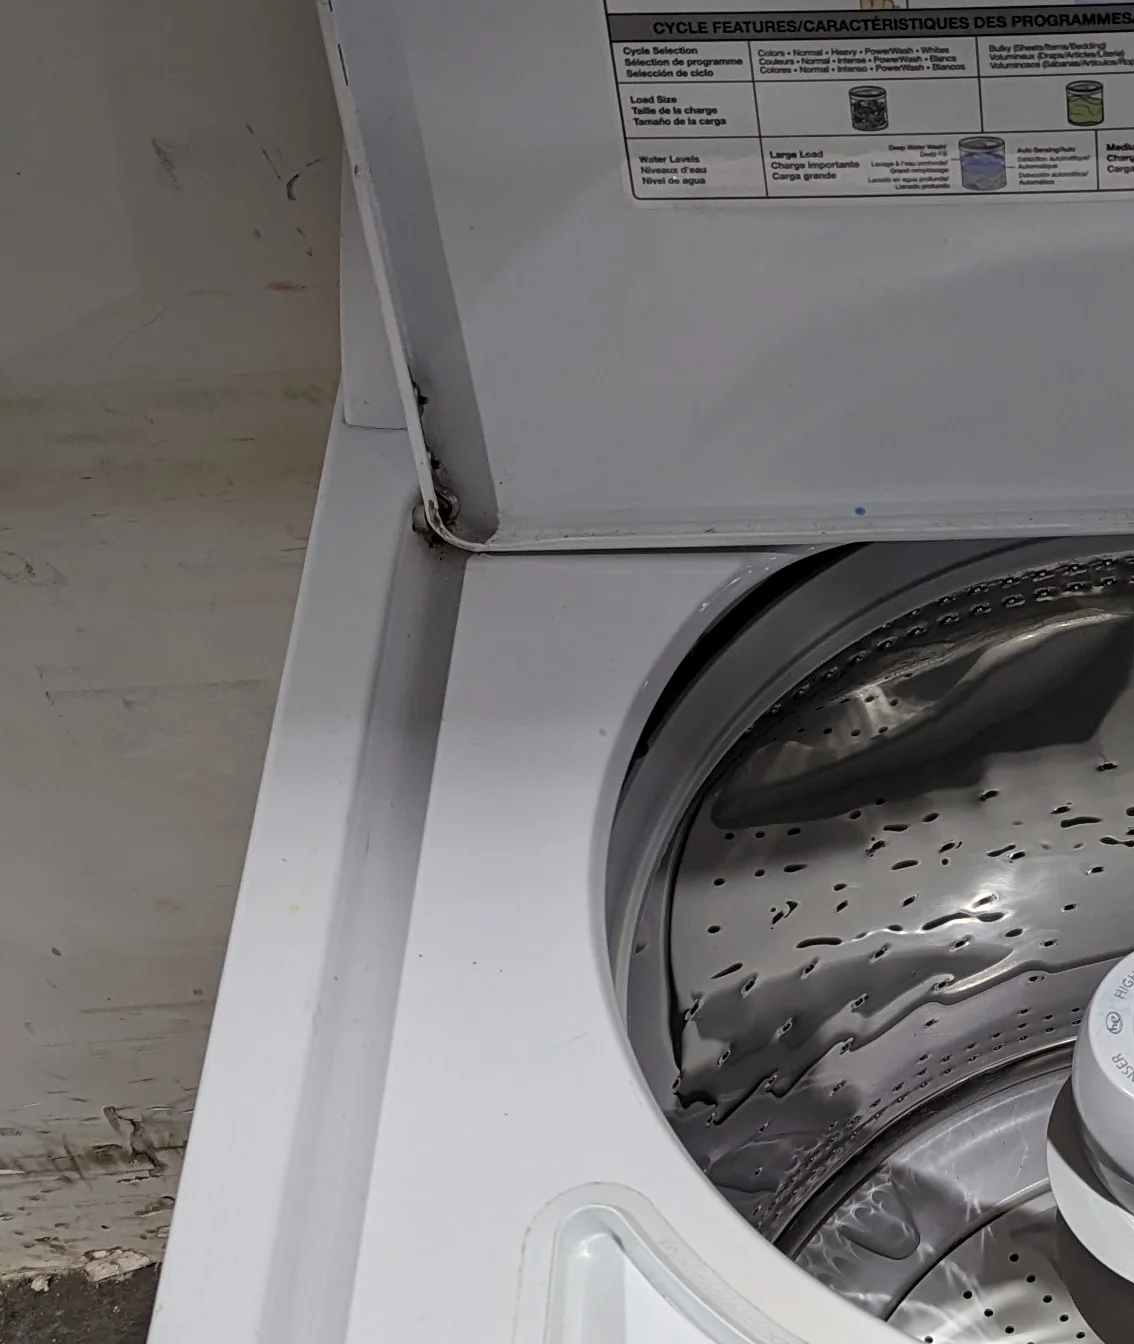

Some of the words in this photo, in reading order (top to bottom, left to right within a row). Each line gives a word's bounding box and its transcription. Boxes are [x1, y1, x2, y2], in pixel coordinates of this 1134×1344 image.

[653, 20, 707, 34] CYCLE
[712, 15, 969, 35] FEATURES/CARACTÉRISTIQUES
[973, 15, 1007, 28] DES
[622, 46, 650, 56] Cycle
[651, 46, 698, 54] Selection
[624, 57, 670, 66] Sélection
[686, 59, 743, 67] programme
[625, 69, 674, 77] Selección
[675, 69, 688, 77] de
[689, 69, 714, 77] ciclo
[629, 95, 655, 103] Load
[656, 95, 677, 103] Size
[631, 106, 656, 114] Taille
[672, 106, 682, 114] la
[683, 106, 718, 115] charge
[633, 117, 671, 125] Tamaño
[672, 117, 685, 125] de
[687, 117, 697, 125] la
[698, 118, 727, 126] carga
[638, 155, 667, 163] Water
[668, 155, 700, 163] Levels
[769, 150, 797, 160] Large
[798, 150, 824, 158] Load
[640, 166, 678, 174] Niveaux
[770, 161, 806, 171] Charge
[807, 161, 860, 169] importante
[1106, 164, 1134, 174] Carga
[641, 176, 666, 184] Nivel
[771, 172, 801, 181] Carga
[803, 172, 837, 181] grande
